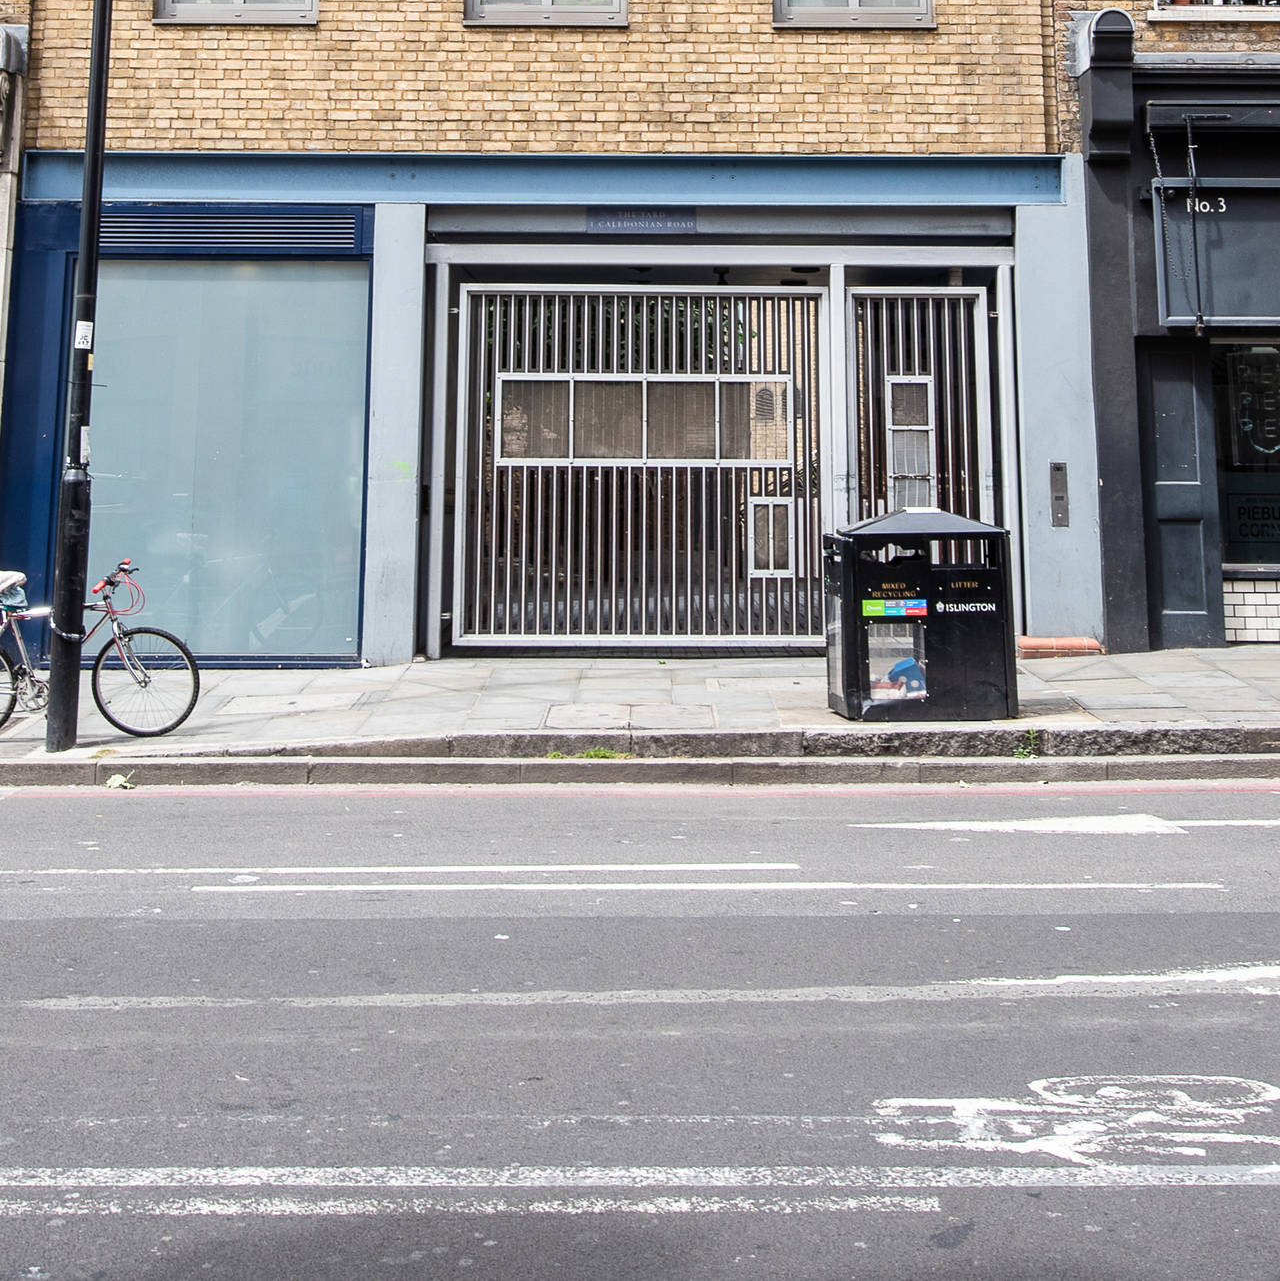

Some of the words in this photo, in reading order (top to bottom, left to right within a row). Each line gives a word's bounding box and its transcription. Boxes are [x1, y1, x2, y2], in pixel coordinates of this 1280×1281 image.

[1186, 197, 1214, 213] No.
[1217, 197, 1227, 213] 3
[945, 603, 996, 612] ISLINGTON
